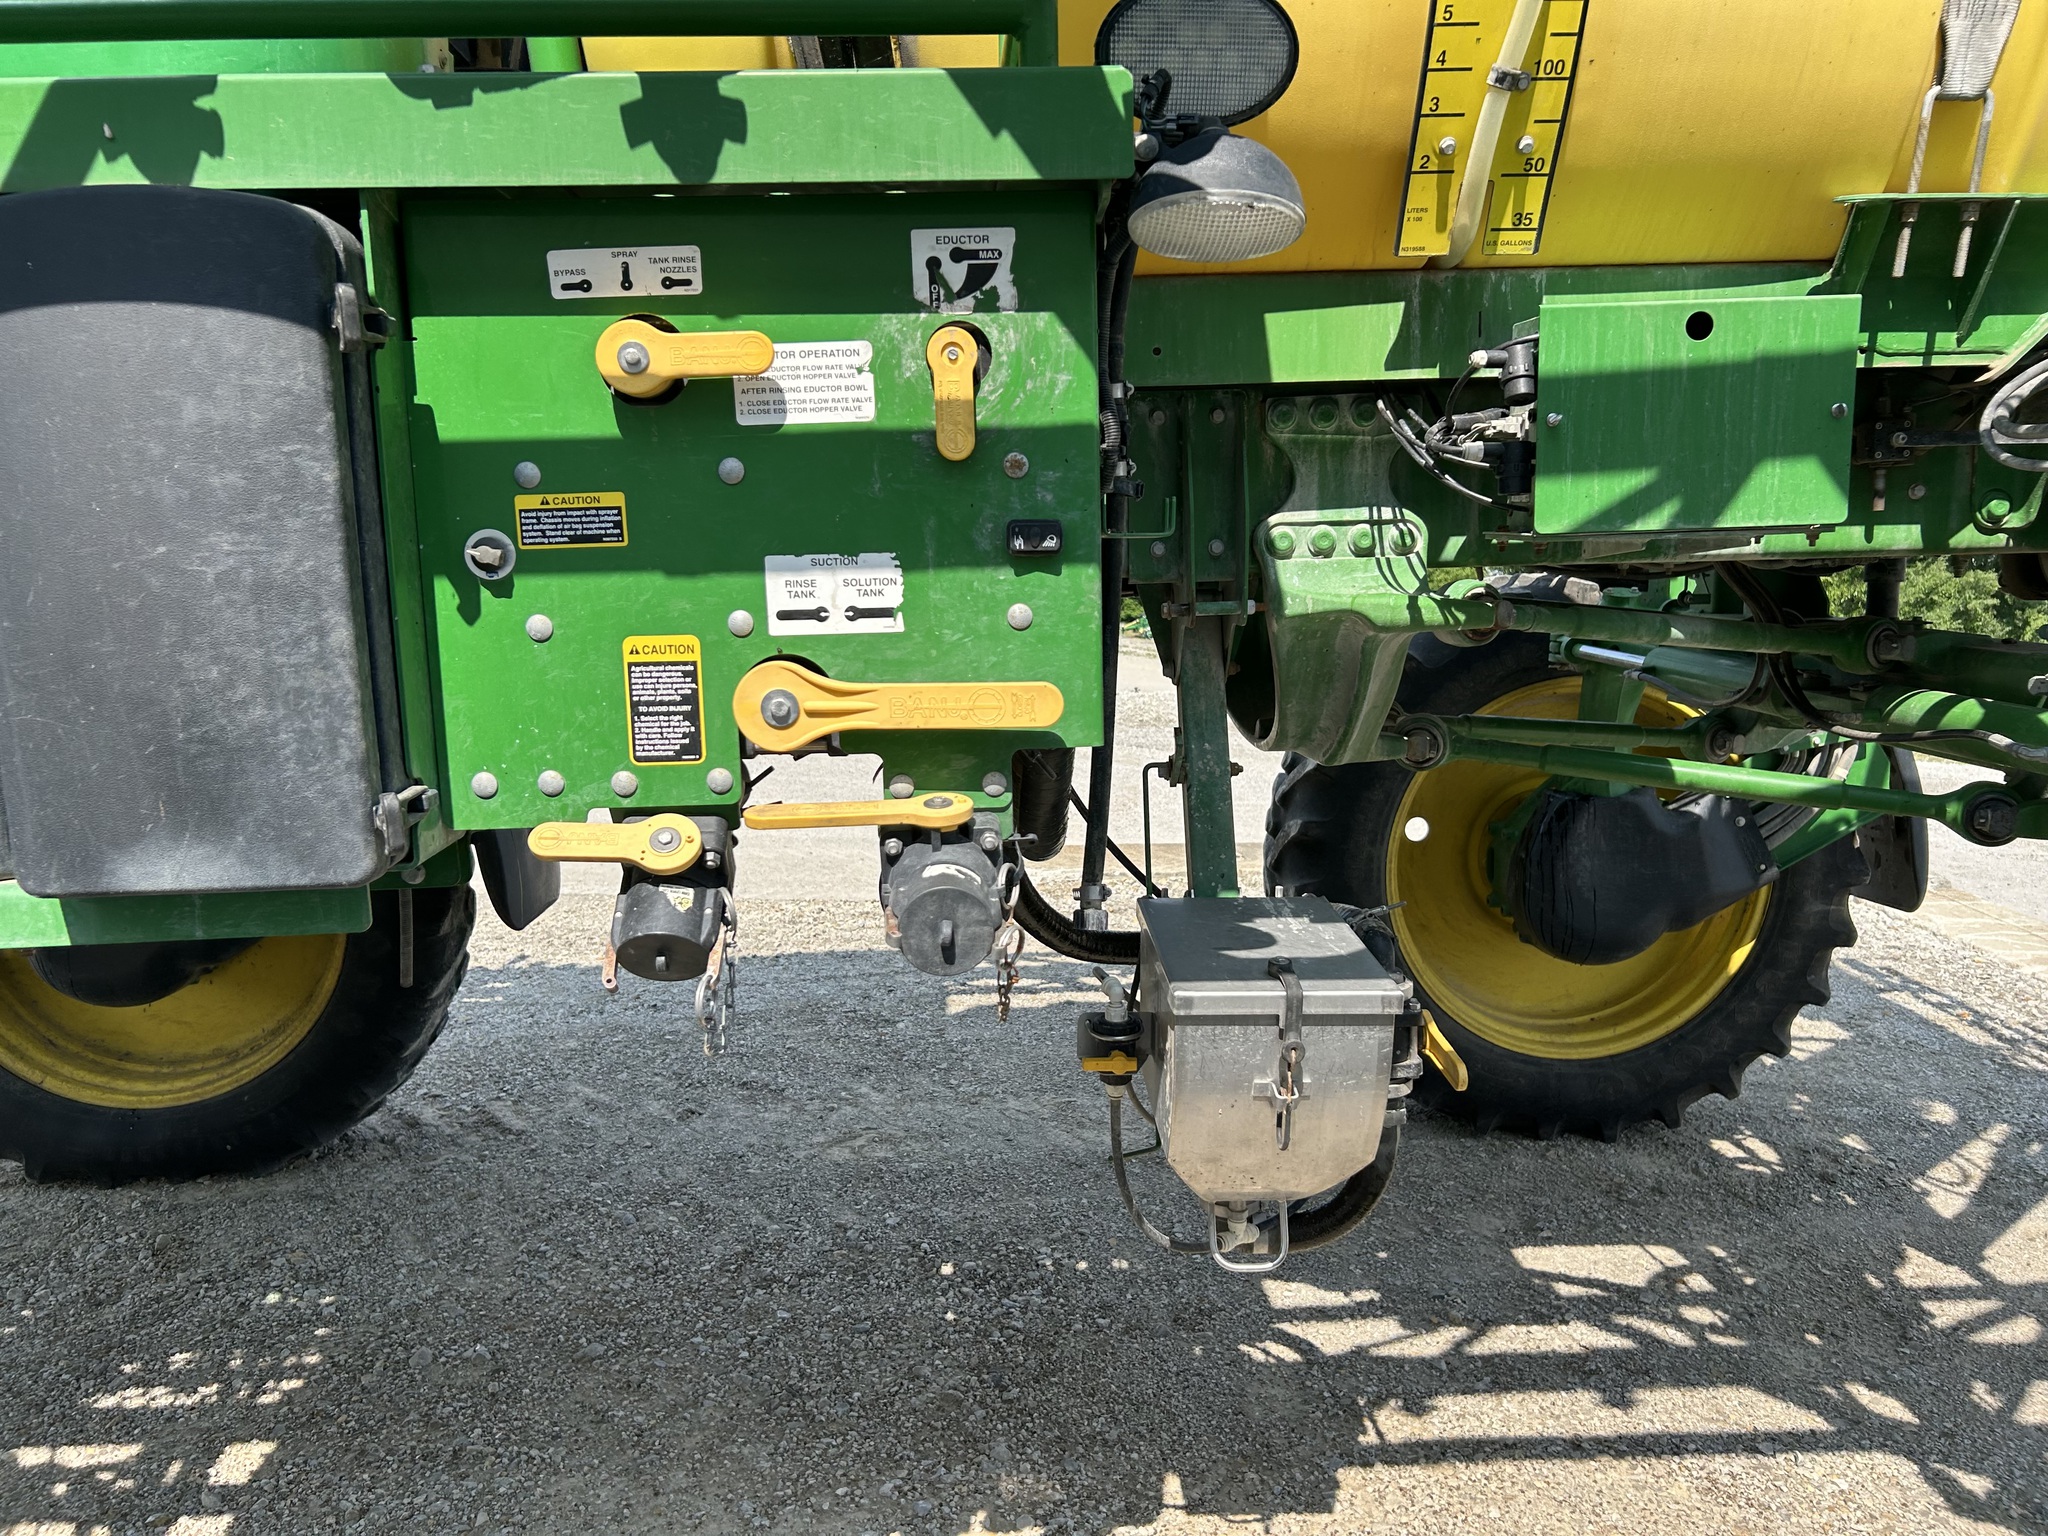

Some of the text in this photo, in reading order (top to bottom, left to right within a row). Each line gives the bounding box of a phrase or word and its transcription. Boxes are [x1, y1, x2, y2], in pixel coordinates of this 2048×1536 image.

[1443, 5, 1454, 21] 5
[1436, 50, 1447, 66] 4
[1534, 60, 1565, 75] 100
[1429, 97, 1440, 112] 3
[1420, 155, 1430, 169] 2
[1523, 158, 1545, 172] 50
[1513, 213, 1533, 226] 35
[935, 235, 990, 245] EDUCTOR
[979, 251, 999, 259] MAX
[554, 269, 586, 277] BYPASS
[799, 349, 860, 359] OPERATION
[770, 386, 801, 394] RINSING
[552, 496, 600, 505] CAUTION
[810, 558, 858, 566] SUCTION
[785, 579, 817, 588] RINSE
[843, 578, 897, 587] SOLUTION
[787, 590, 816, 599] TANK
[857, 589, 885, 597] TANK
[642, 644, 695, 655] CAUTION
